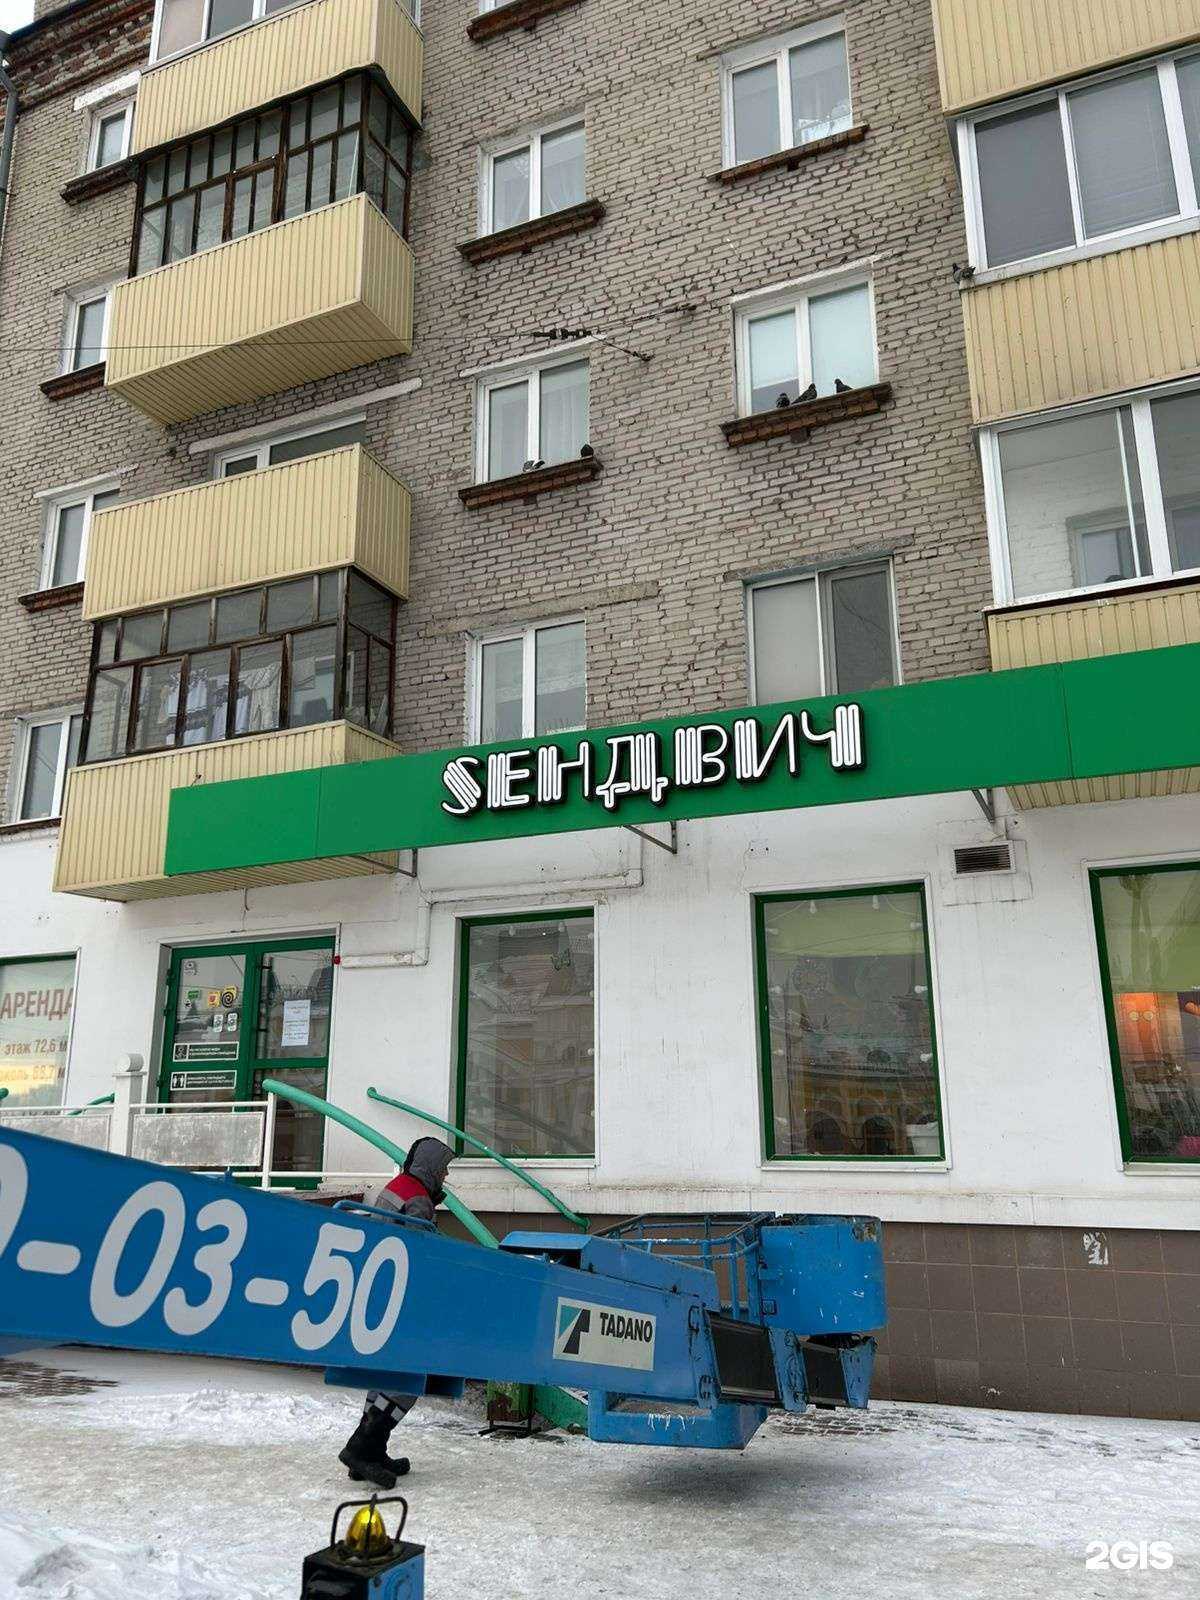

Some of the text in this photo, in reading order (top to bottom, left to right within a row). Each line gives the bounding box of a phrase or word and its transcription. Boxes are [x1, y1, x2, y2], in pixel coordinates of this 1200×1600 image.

[4, 1042, 31, 1056] этаж
[35, 1038, 56, 1056] 72,6
[600, 1312, 653, 1343] TADANO
